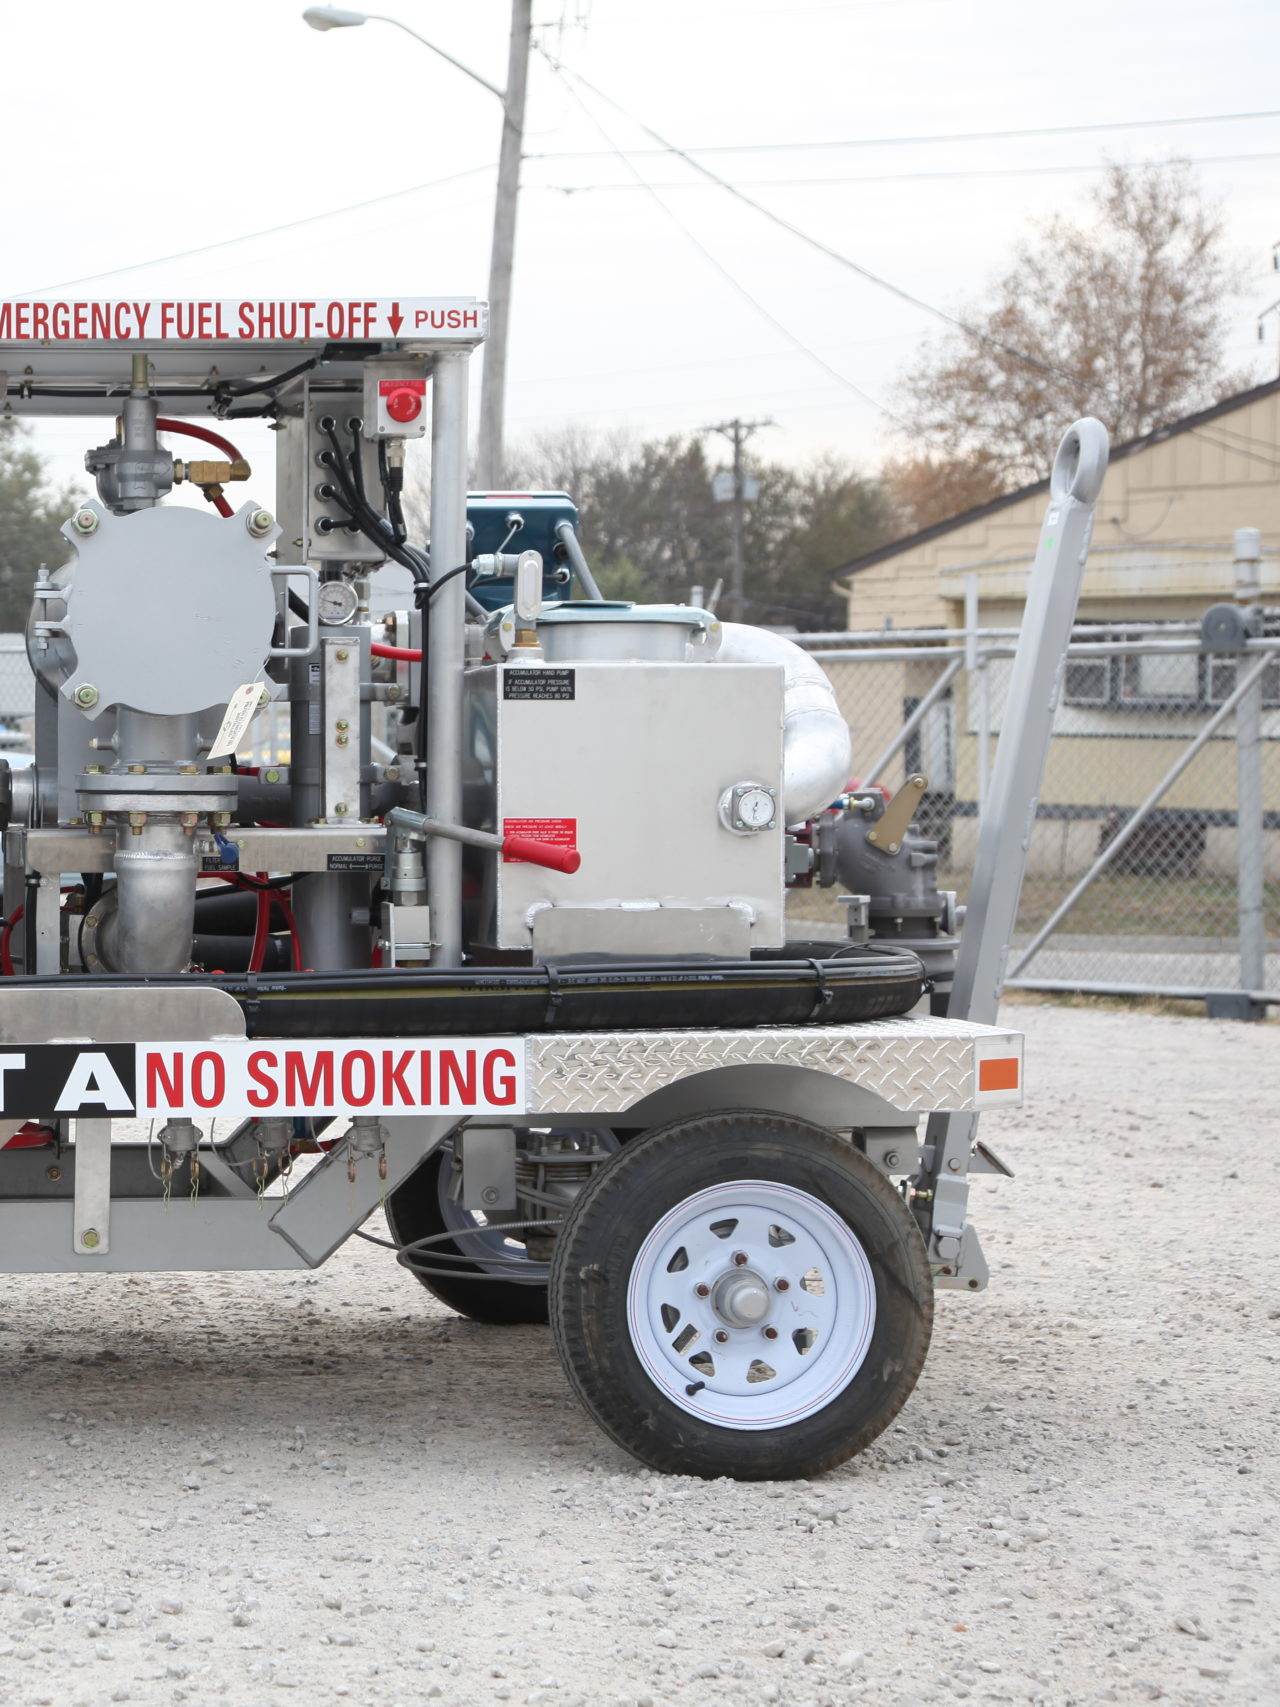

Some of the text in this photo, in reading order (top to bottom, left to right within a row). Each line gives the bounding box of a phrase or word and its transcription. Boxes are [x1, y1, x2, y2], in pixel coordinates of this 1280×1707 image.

[161, 302, 229, 339] FUEL
[238, 301, 377, 339] SHUT-OFF
[415, 310, 478, 328] PUSH
[53, 1053, 135, 1112] A
[146, 1048, 517, 1109] NO SMOKING
